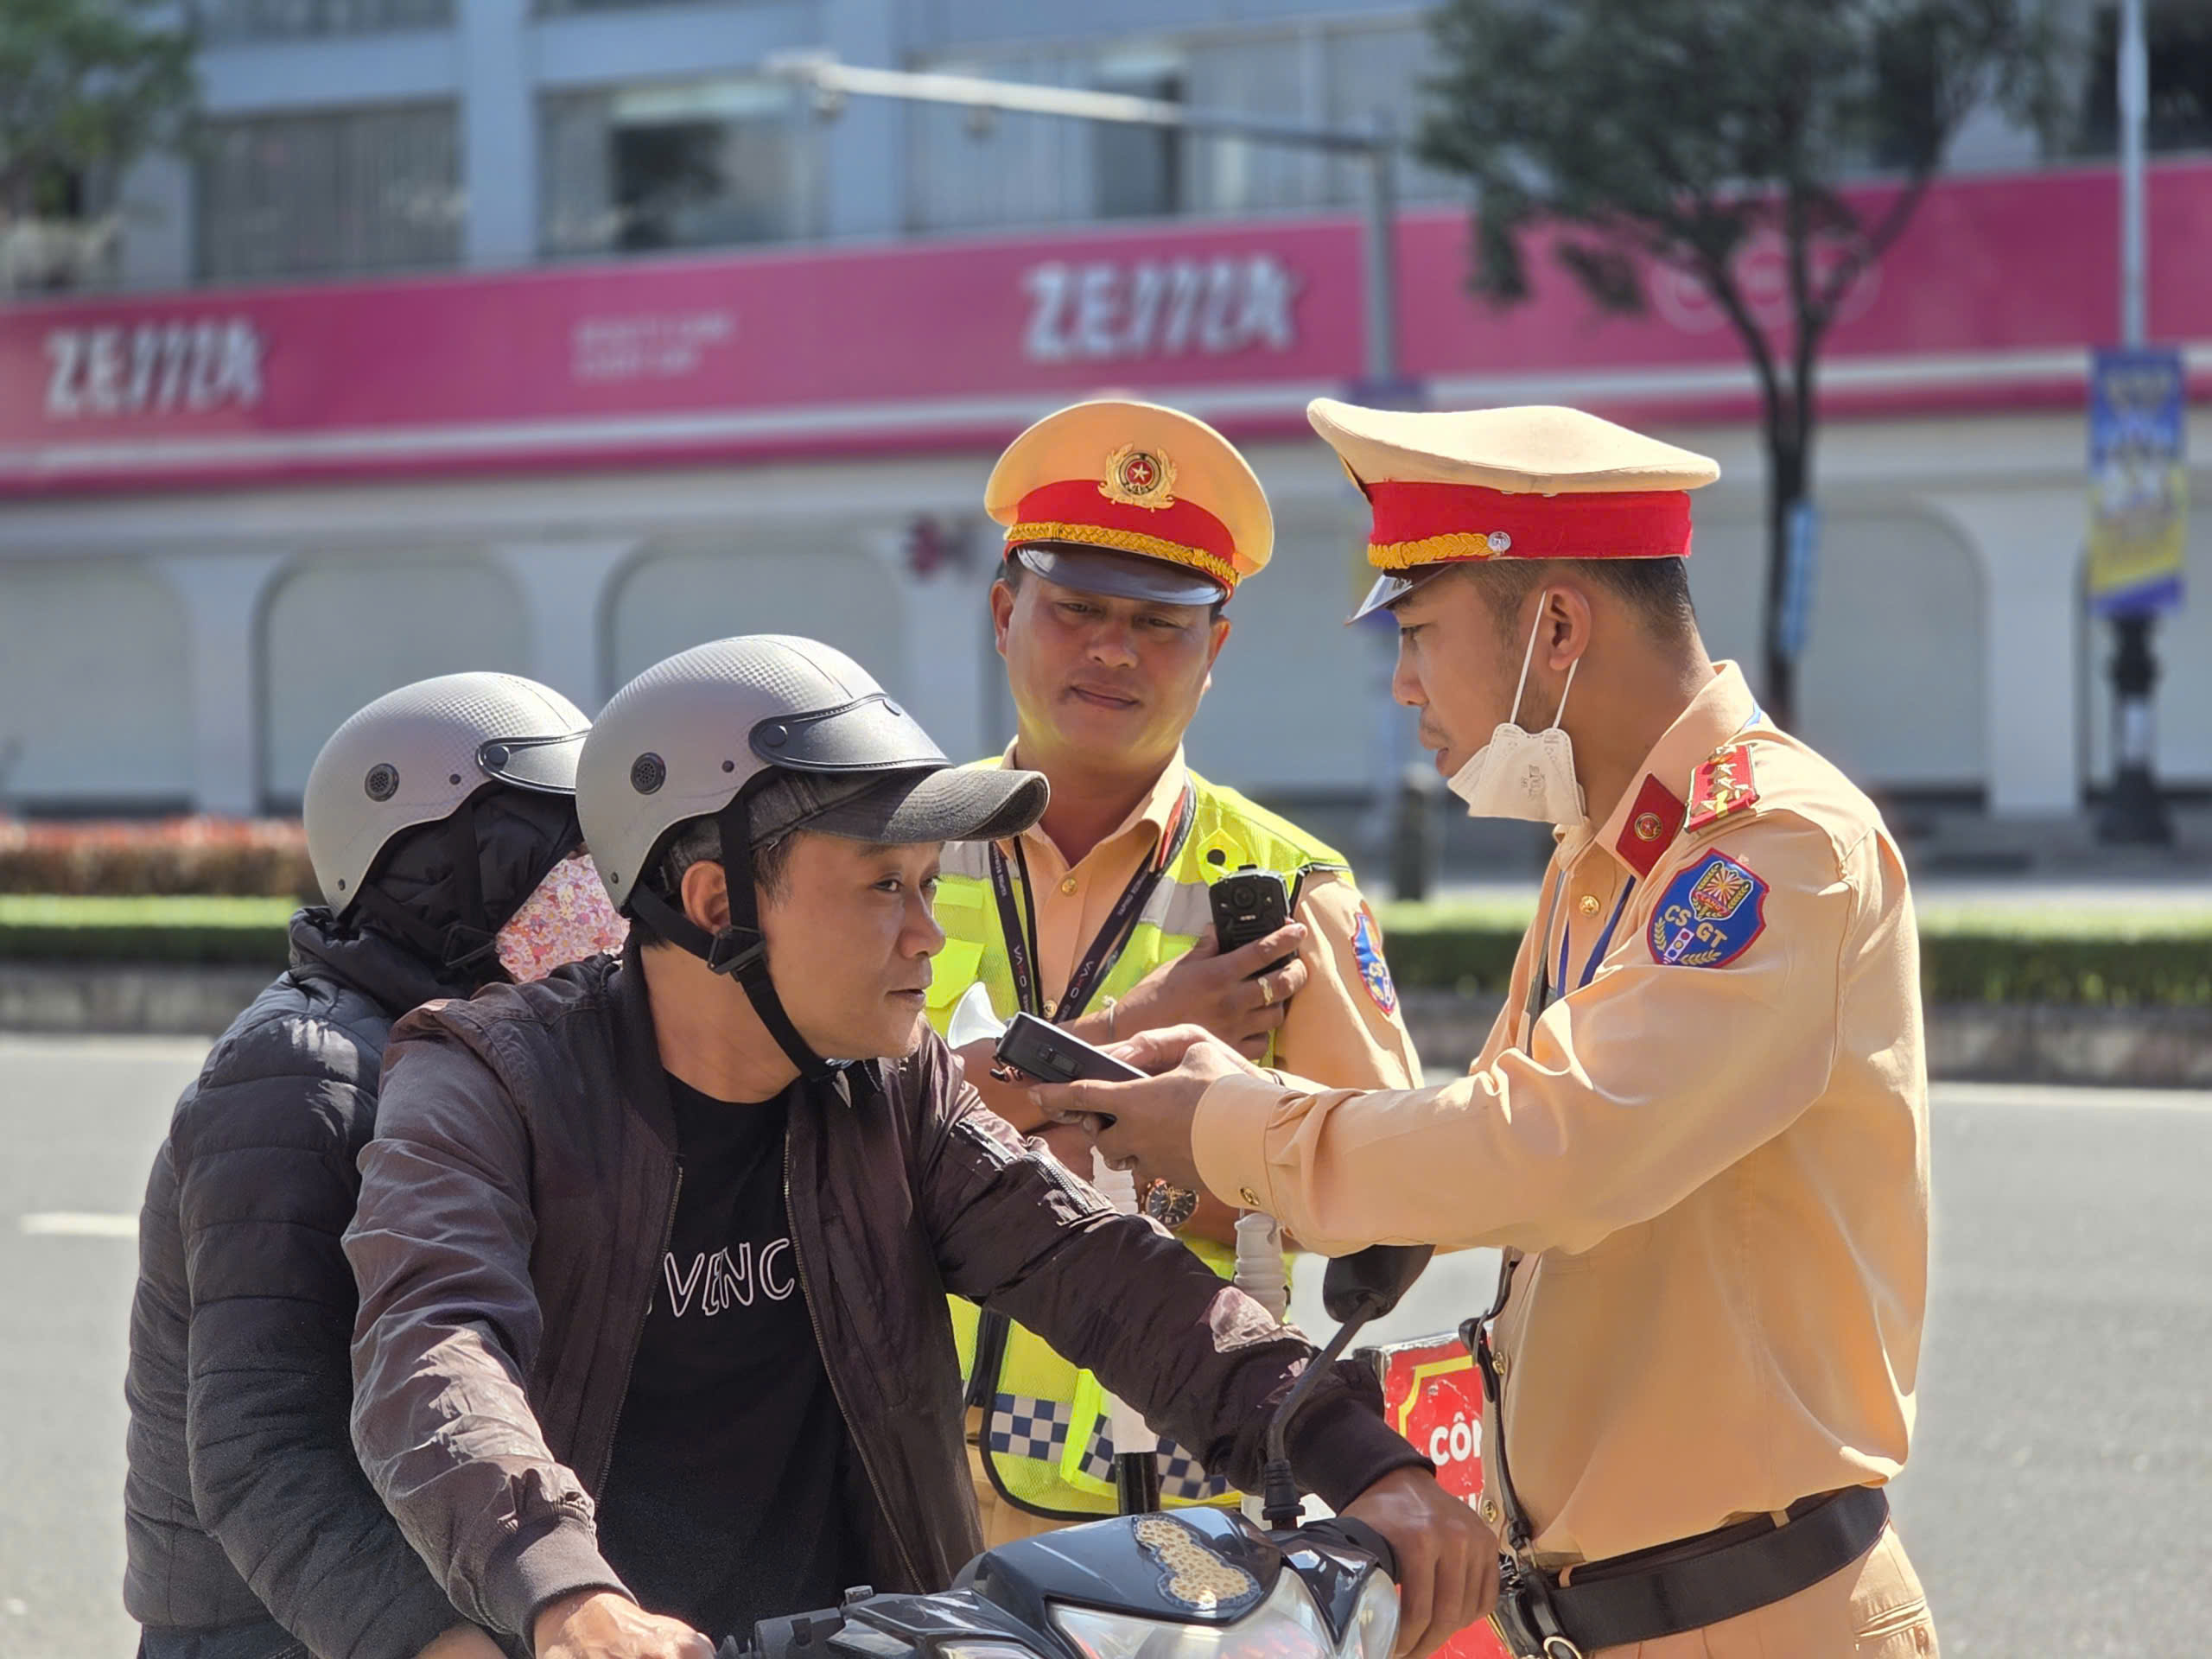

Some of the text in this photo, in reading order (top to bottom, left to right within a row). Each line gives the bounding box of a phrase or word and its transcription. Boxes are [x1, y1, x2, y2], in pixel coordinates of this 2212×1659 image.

[1664, 905, 1727, 948] CS GT
[647, 1237, 795, 1318] VENC
